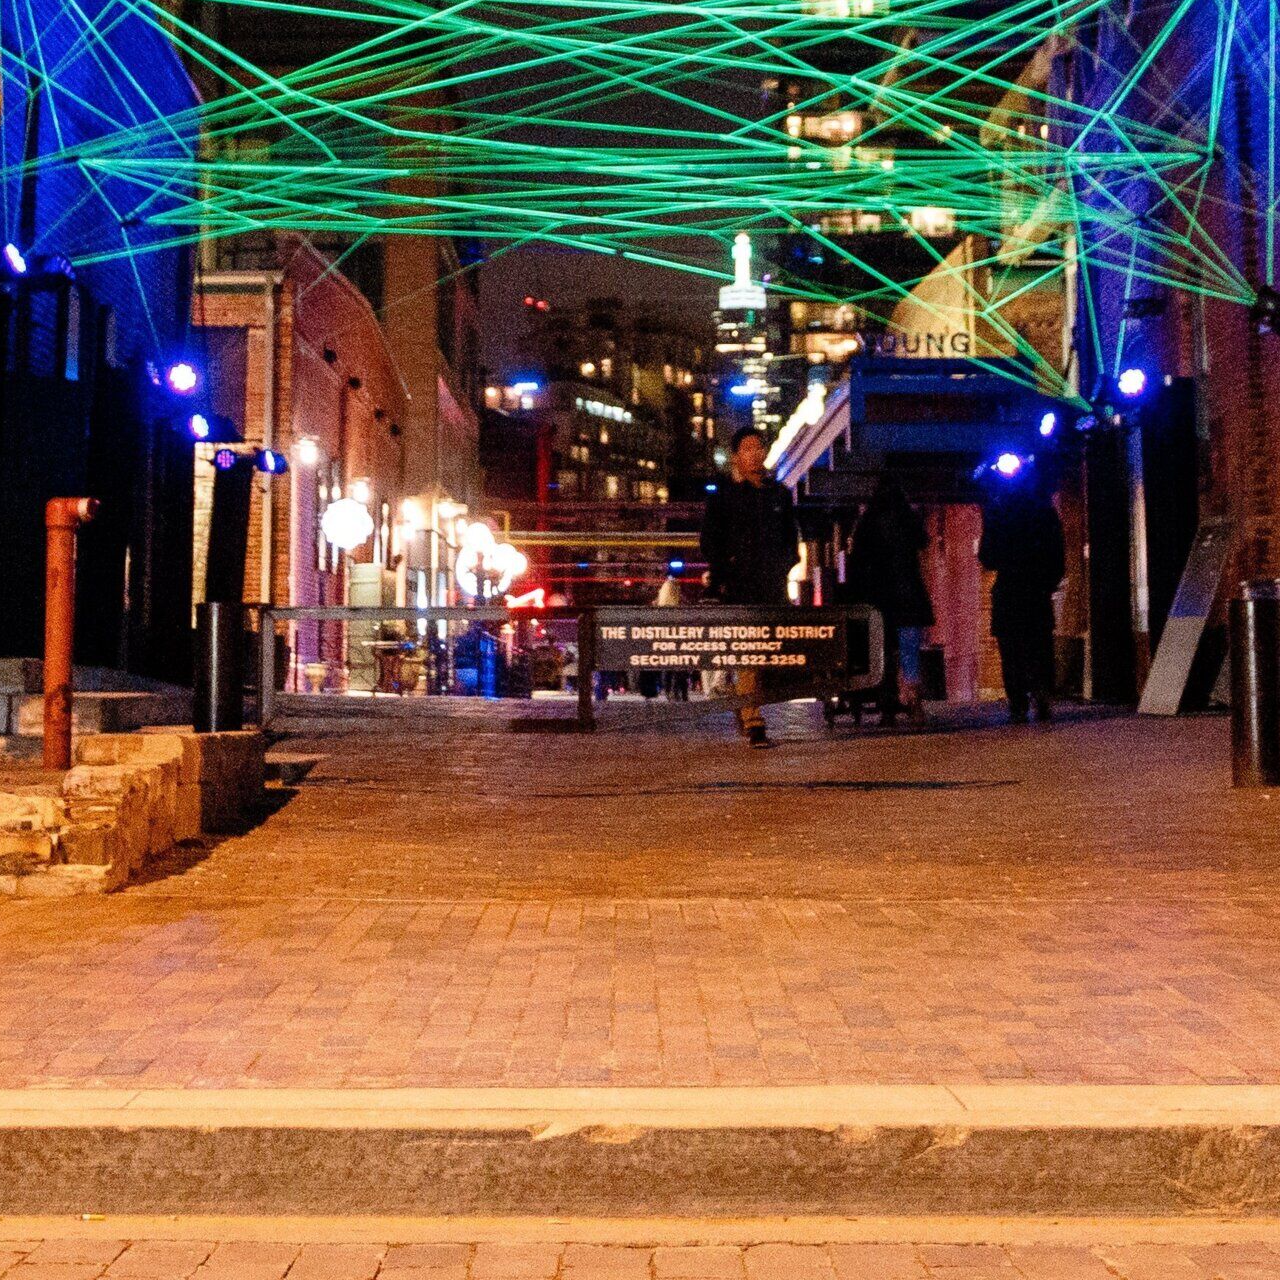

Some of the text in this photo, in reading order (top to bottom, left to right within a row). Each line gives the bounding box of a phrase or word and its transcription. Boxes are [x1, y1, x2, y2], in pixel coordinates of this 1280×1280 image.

[600, 626, 836, 639] THE DISTILLERY HISTORIC DISTRICT
[652, 641, 783, 651] FOR ACCESS CONTACT
[630, 654, 701, 666] SECURITY
